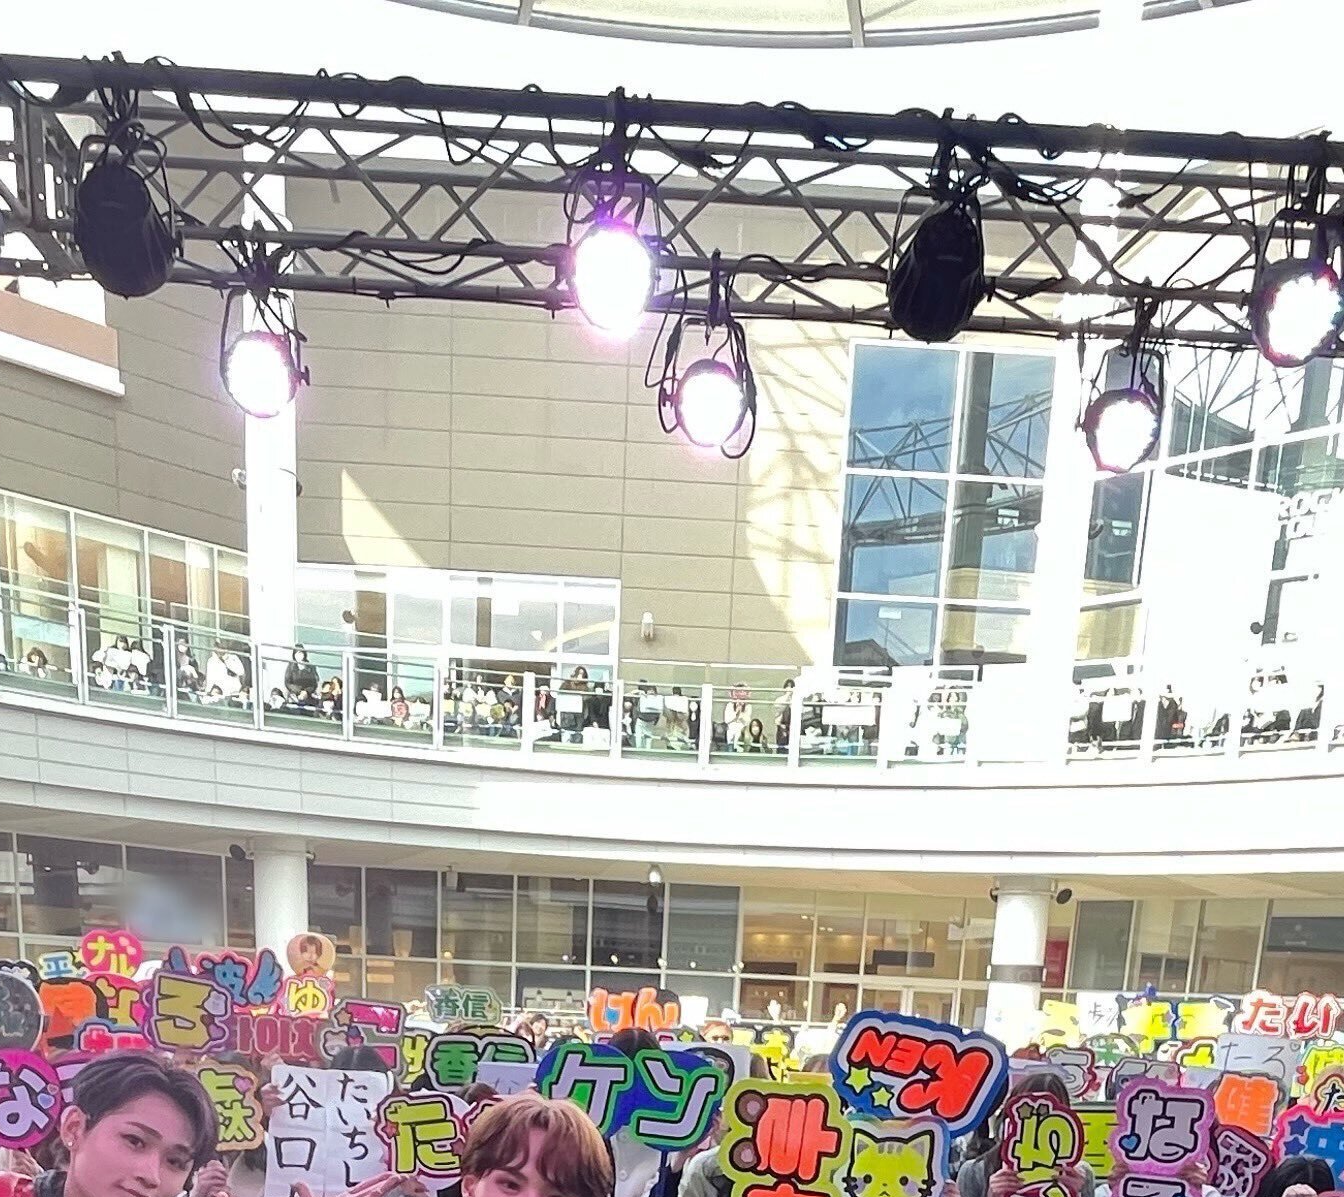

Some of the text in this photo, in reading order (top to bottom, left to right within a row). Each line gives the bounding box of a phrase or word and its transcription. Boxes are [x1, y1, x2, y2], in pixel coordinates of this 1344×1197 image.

[590, 986, 680, 1032] けん
[552, 1053, 718, 1141] ケン
[851, 1027, 993, 1118] KEN
